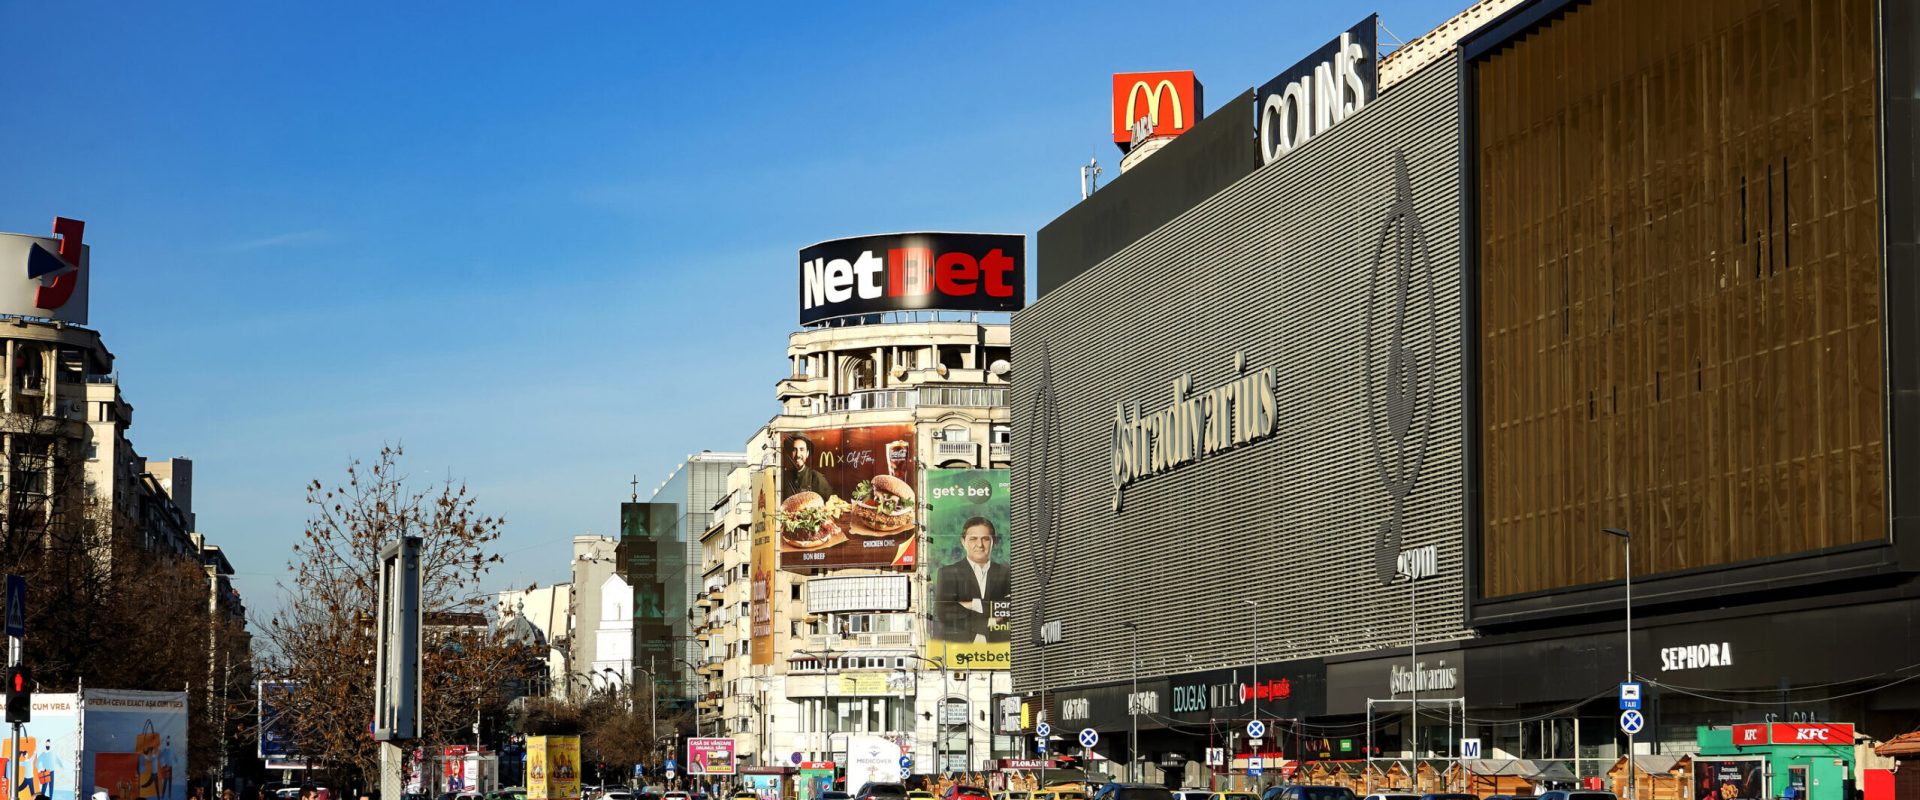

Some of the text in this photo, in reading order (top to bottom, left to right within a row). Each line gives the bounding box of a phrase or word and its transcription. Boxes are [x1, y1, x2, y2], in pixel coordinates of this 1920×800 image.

[1261, 32, 1364, 165] COLIN'S
[803, 247, 1015, 310] NetBet
[967, 485, 990, 497] bet
[1661, 642, 1732, 671] SEPHORA
[1174, 684, 1207, 712] DOUGLAS
[1744, 729, 1757, 740] KFC
[1796, 728, 1829, 740] KFC
[1465, 742, 1478, 757] M
